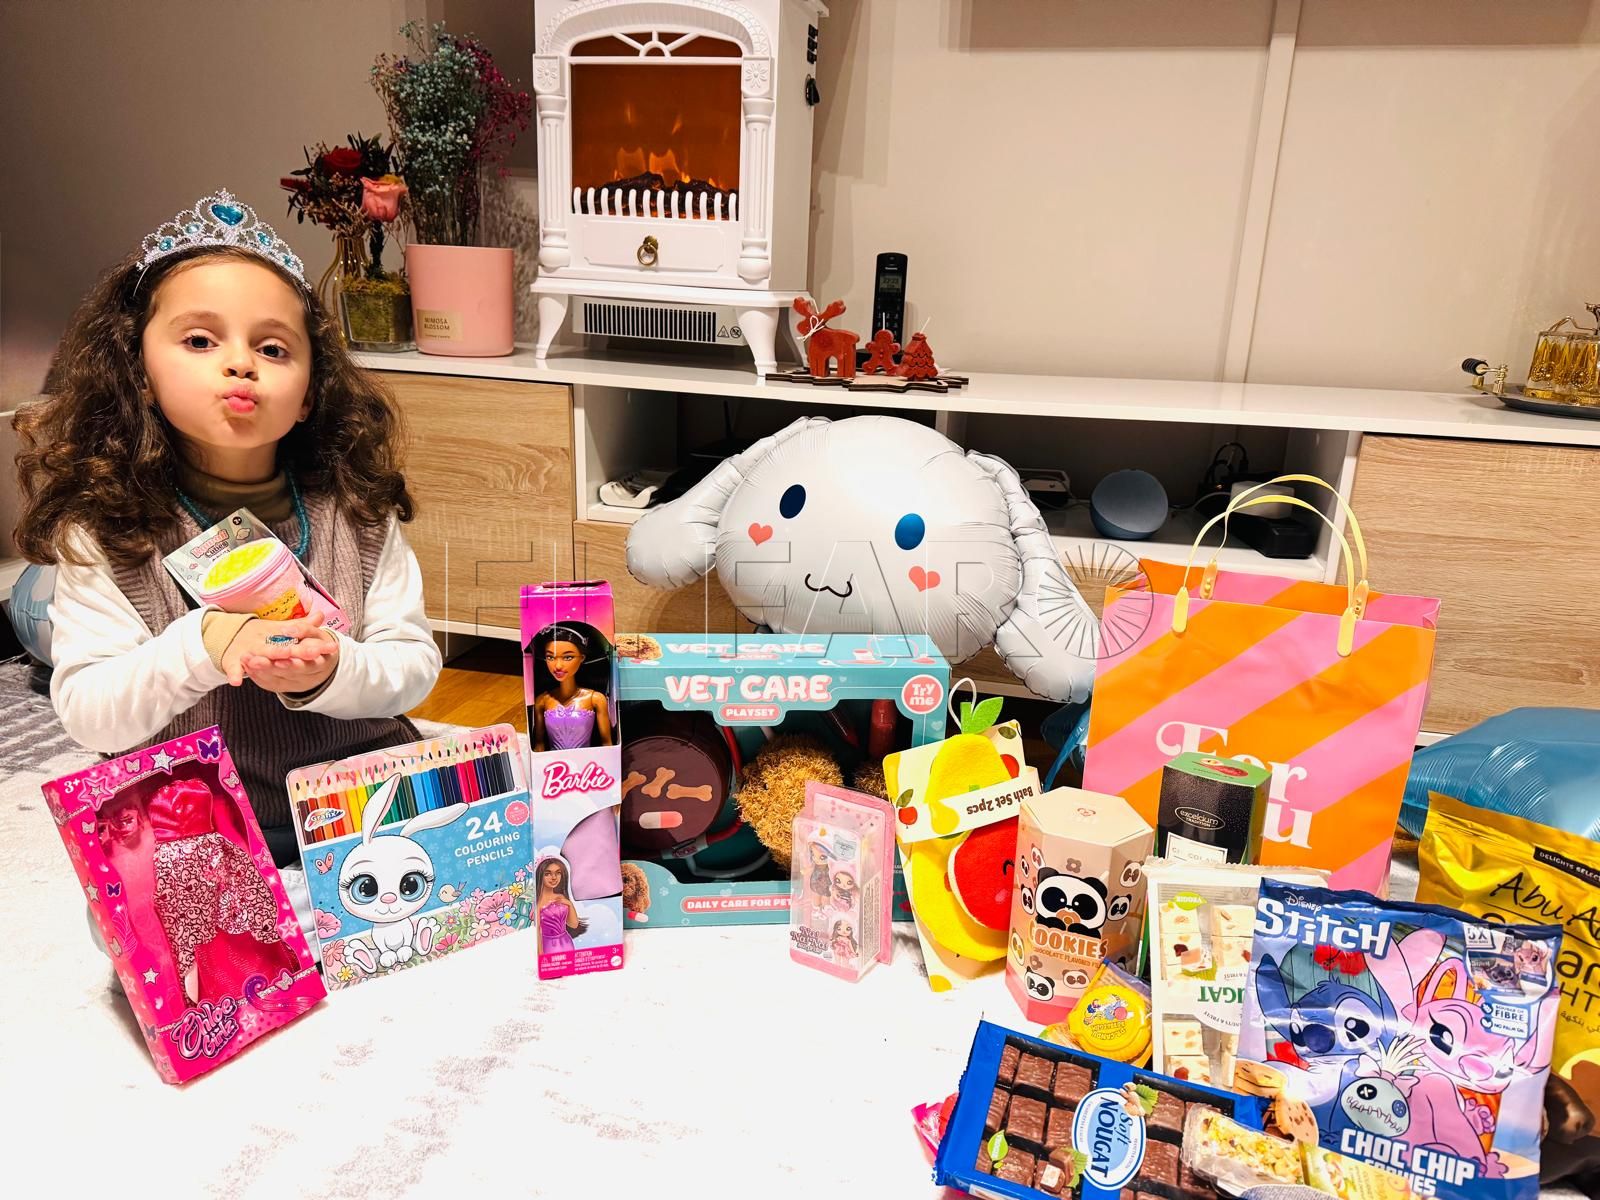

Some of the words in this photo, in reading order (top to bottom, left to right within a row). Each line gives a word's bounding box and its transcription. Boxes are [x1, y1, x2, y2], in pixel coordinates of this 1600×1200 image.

[327, 617, 340, 628] Set
[665, 643, 733, 654] VET
[737, 643, 827, 654] CARE
[664, 675, 735, 702] VET
[740, 675, 832, 703] CARE
[911, 682, 935, 697] Try
[910, 694, 935, 706] me
[726, 708, 775, 718] PLAYSET
[1156, 721, 1308, 803] Fr
[63, 777, 81, 794] 3+
[542, 761, 615, 798] Barbie
[995, 794, 1013, 808] Set
[1014, 786, 1034, 802] Bath
[966, 799, 994, 815] 2pcs
[466, 811, 503, 840] 24
[454, 831, 521, 857] COLOURING
[466, 846, 514, 868] PENCILS
[1539, 851, 1574, 870] DELIGHTS
[687, 900, 719, 909] DAILY
[721, 899, 749, 908] CARE
[750, 899, 772, 907] FOR
[774, 898, 792, 907] PET
[1489, 872, 1564, 919] Abu
[1028, 918, 1108, 960] COOKIES
[1033, 946, 1065, 960] CHOCOLATE
[1198, 986, 1245, 1003] UGAT
[1495, 1010, 1524, 1021] FIBRE
[171, 998, 236, 1059] Chloe
[1091, 1097, 1119, 1178] NOUGAT
[1114, 1112, 1134, 1145] Soft
[1341, 1128, 1407, 1169] CHOC
[1412, 1147, 1476, 1186] CHIP
